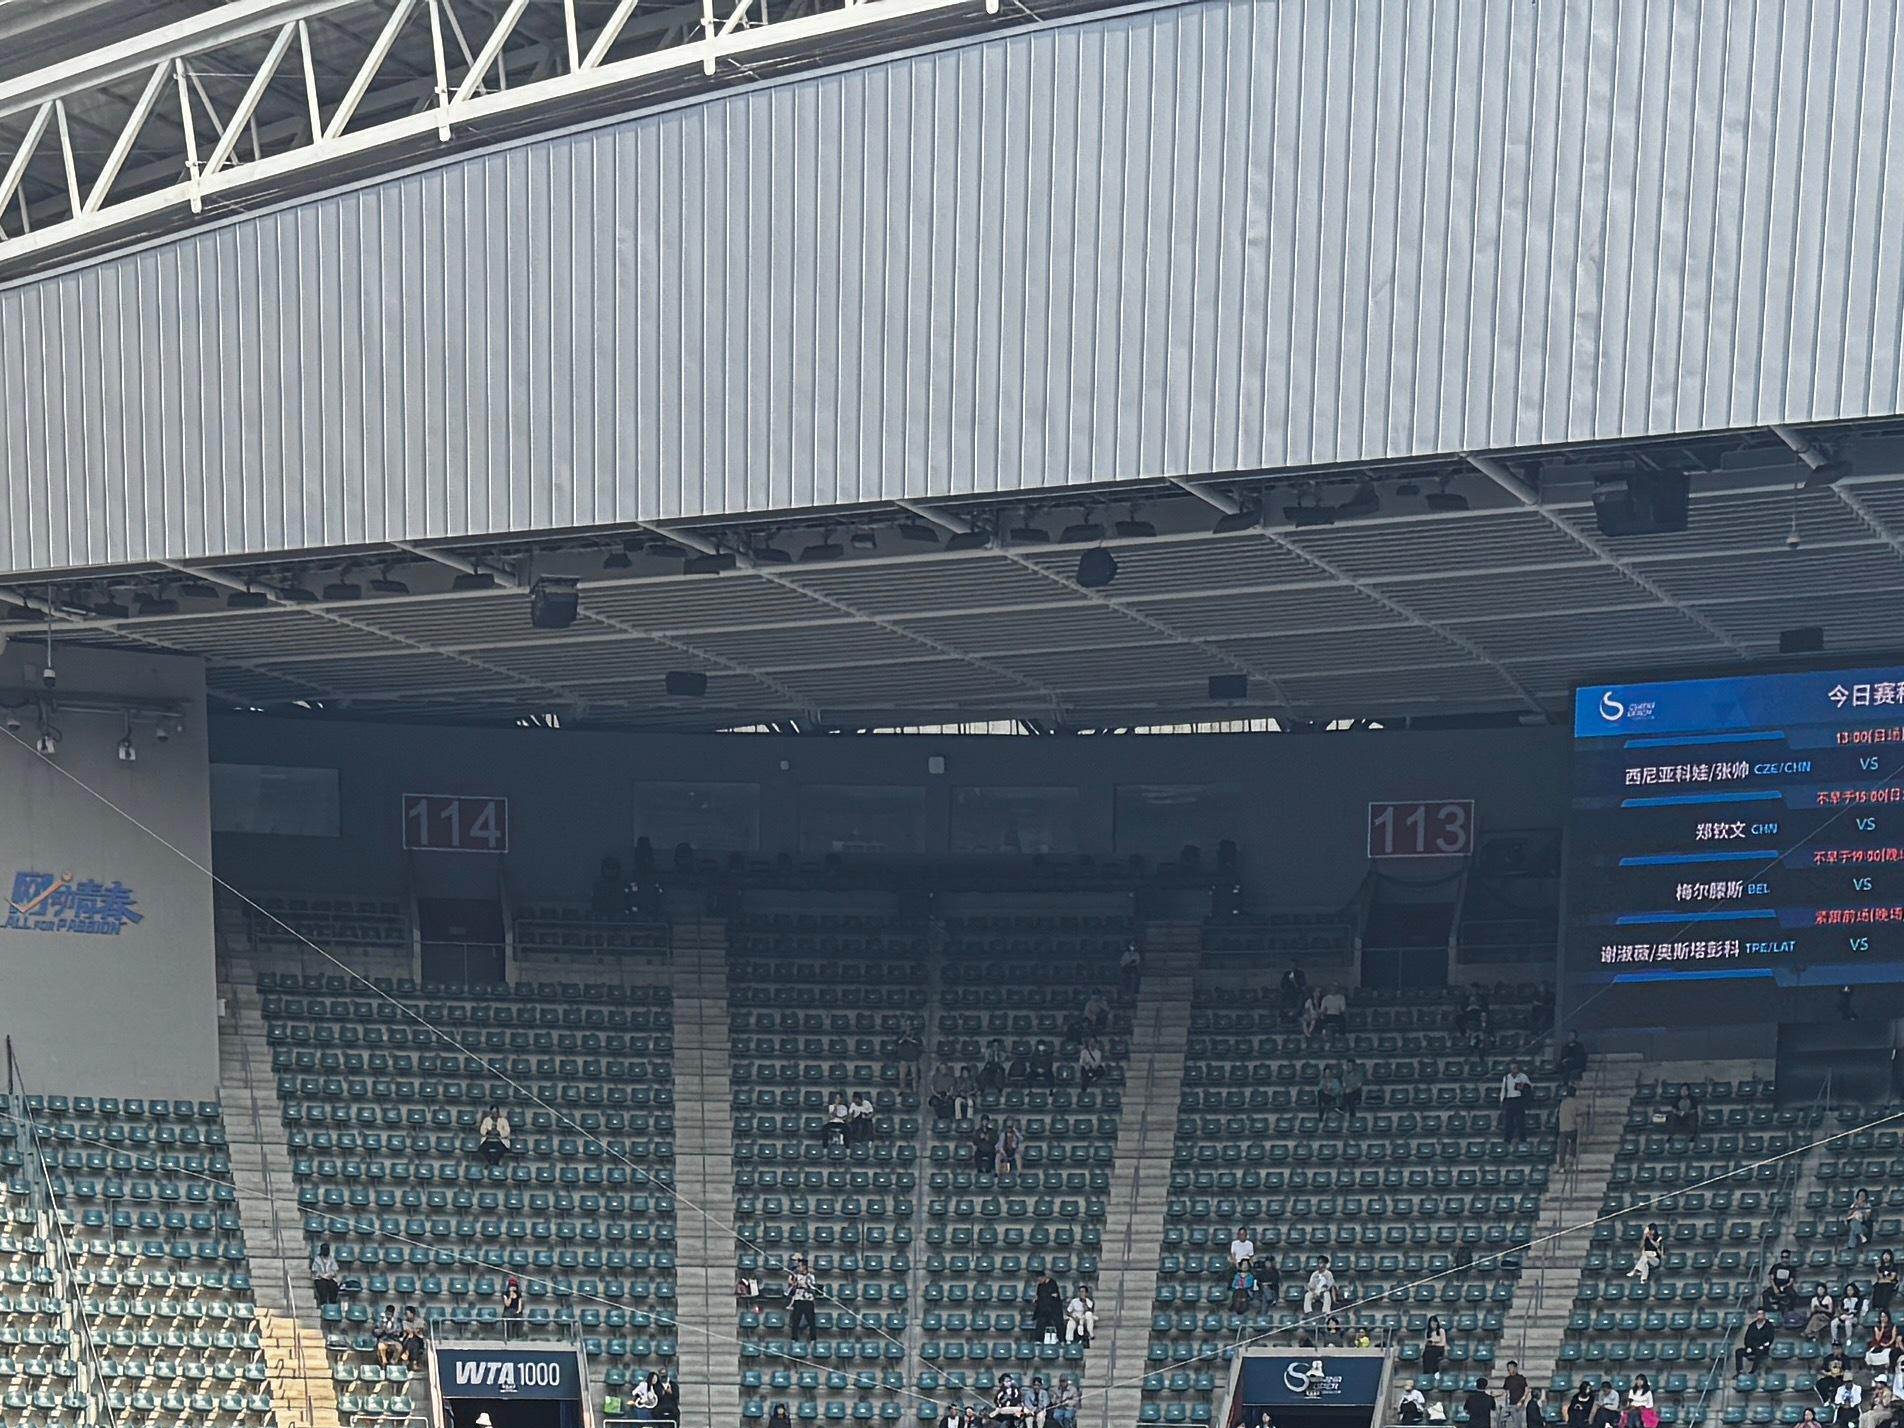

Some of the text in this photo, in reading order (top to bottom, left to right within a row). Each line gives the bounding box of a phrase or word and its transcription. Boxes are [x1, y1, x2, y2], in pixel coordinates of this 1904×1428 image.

[1754, 760, 1812, 776] CZE/CHN
[1859, 757, 1880, 771] VS
[409, 799, 501, 848] 114
[1375, 804, 1465, 853] 113
[1751, 823, 1778, 835] CHN
[1856, 817, 1877, 831] VS
[1748, 883, 1770, 895] BEL
[1853, 877, 1873, 891] VS
[1746, 940, 1796, 955] TPE/LAT
[1849, 937, 1869, 952] VS
[456, 1361, 560, 1386] WTA 1000
